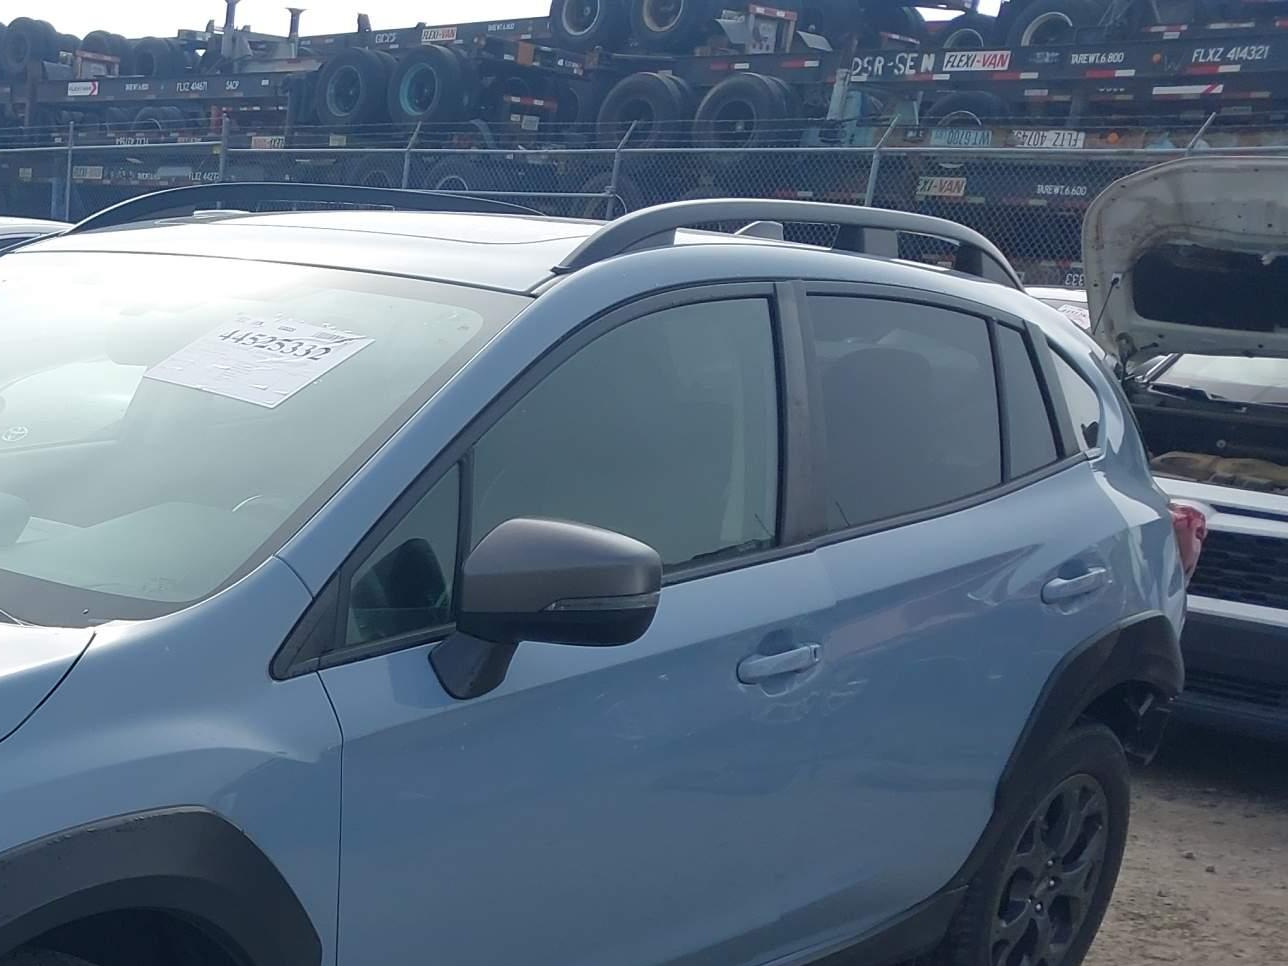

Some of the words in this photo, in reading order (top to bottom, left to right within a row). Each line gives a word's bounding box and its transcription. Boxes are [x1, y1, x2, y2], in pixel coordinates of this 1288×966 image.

[945, 53, 1009, 69] FLEXI-VAN
[1192, 48, 1222, 62] FLXZ
[1226, 46, 1270, 61] 414321
[218, 329, 331, 360] 44525332
